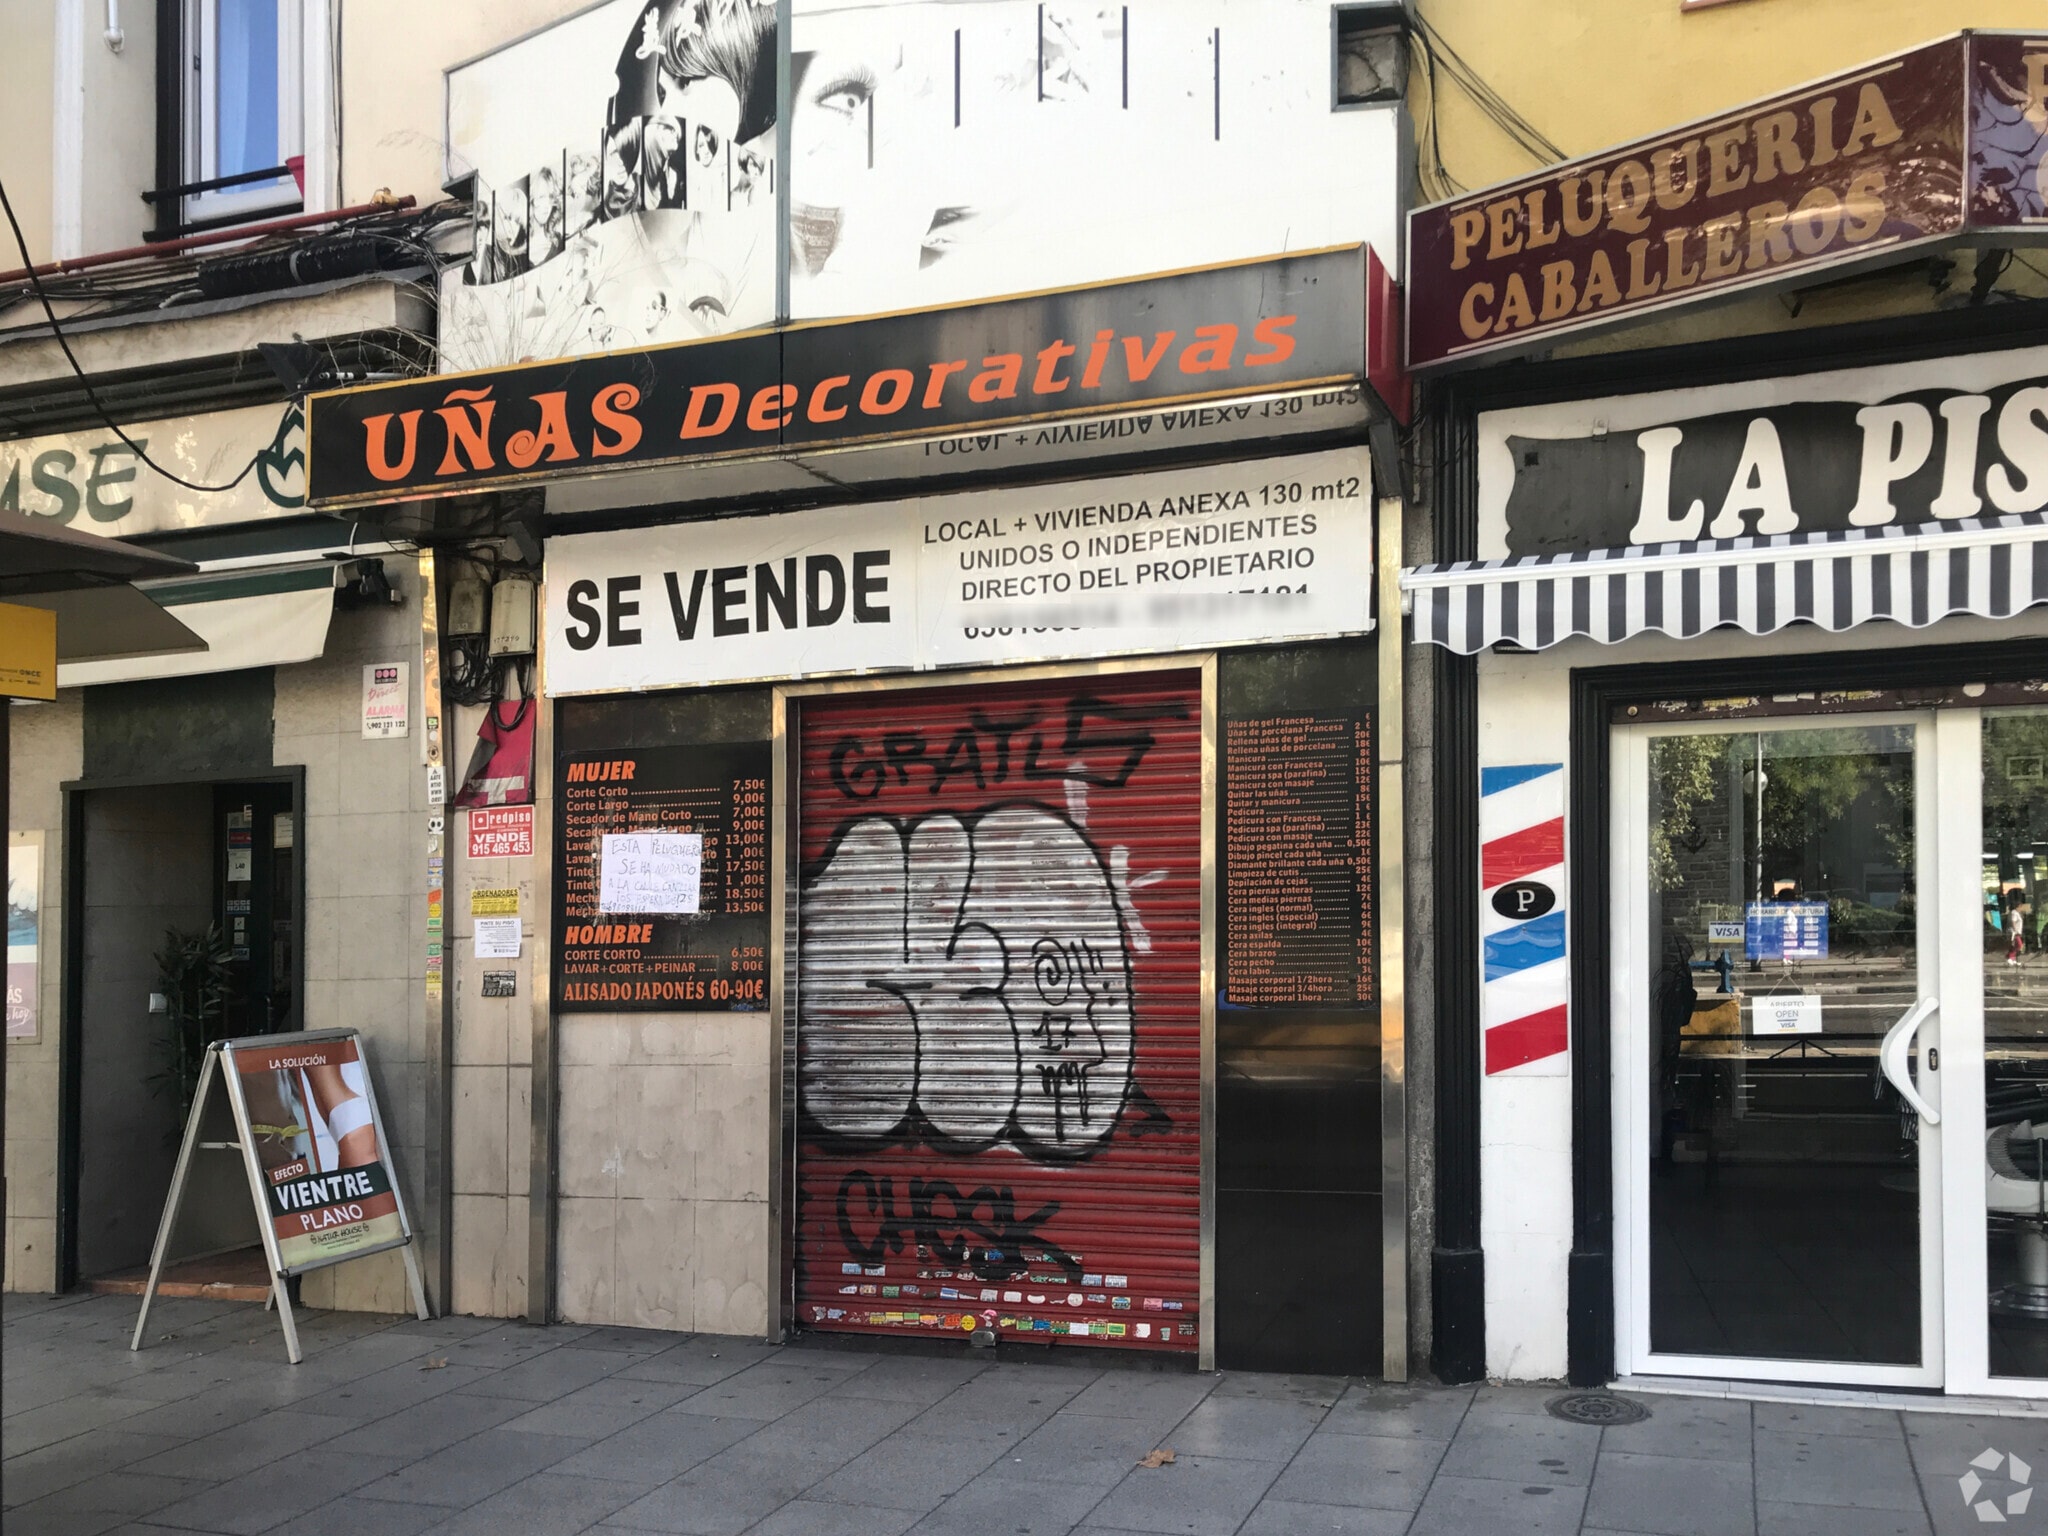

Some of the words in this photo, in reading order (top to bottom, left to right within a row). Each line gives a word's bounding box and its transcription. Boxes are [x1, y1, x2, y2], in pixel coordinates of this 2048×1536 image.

[1449, 82, 1903, 270] PELUQUERIA
[1459, 170, 1888, 340] CABALLEROS
[362, 382, 643, 481] UÑAS
[679, 314, 1297, 440] Decorativas
[1629, 417, 1799, 546] LA
[1848, 386, 2048, 527] PIS
[924, 516, 1006, 544] LOCAL
[1034, 501, 1152, 532] VIVIENDA
[1159, 490, 1251, 518] ANEXA
[1258, 482, 1302, 507] 130
[1312, 477, 1360, 501] mt2
[960, 543, 1053, 570] UNIDOS
[1062, 539, 1080, 559] O
[1088, 513, 1318, 558] INDEPENDIENTES
[962, 572, 1071, 601] DIRECTO
[1079, 566, 1128, 591] DEL
[1136, 546, 1315, 584] PROPIETARIO
[565, 574, 642, 651] SE
[663, 549, 891, 642] VENDE
[1227, 720, 1248, 728] Uñas
[1250, 719, 1259, 727] de
[1261, 718, 1274, 727] gel
[1276, 717, 1314, 726] Francesa
[566, 760, 637, 782] MUJER
[1227, 764, 1264, 772] Manicura
[1285, 761, 1323, 770] Francesa
[566, 788, 596, 798] Corte
[598, 786, 628, 797] Corto
[733, 778, 765, 792] 7,50€
[1227, 790, 1253, 799] Quitar
[1269, 789, 1289, 797] uñas
[566, 801, 596, 811] Corte
[599, 801, 629, 813] Largo
[733, 792, 765, 805] 9,00€
[490, 811, 531, 824] redpiso
[566, 814, 609, 825] Secador
[612, 812, 626, 823] de
[628, 812, 658, 822] Mano
[661, 810, 692, 821] Corto
[733, 806, 765, 819] 7,00€
[566, 827, 609, 838] Secador
[733, 820, 765, 832] 9,00€
[1227, 826, 1264, 834] Pedicura
[1266, 826, 1281, 834] spa
[1282, 822, 1325, 832] (parafina)
[474, 831, 529, 843] VENDE
[725, 834, 765, 846] 13,00€
[472, 844, 490, 855] 915
[492, 843, 510, 854] 465
[512, 841, 530, 853] 453
[1228, 844, 1255, 853] Dibujo
[1257, 842, 1293, 851] pegatina
[1316, 840, 1332, 848] uña
[567, 867, 593, 877] Tinte
[726, 861, 765, 873] 17,50€
[1228, 861, 1267, 869] Diamante
[1269, 859, 1305, 867] brillante
[1307, 858, 1327, 866] cada
[1329, 857, 1345, 865] uña
[1228, 869, 1265, 878] Limpieza
[1279, 868, 1299, 876] cutis
[566, 880, 593, 890] Tinte
[1228, 888, 1248, 896] Cera
[1249, 887, 1280, 895] piernas
[1282, 886, 1313, 894] enteras
[566, 893, 600, 903] Mecha
[1515, 889, 1537, 912] P
[566, 906, 602, 916] Mecha
[725, 902, 765, 914] 13,50€
[565, 924, 653, 944] HOMBRE
[1715, 928, 1740, 936] VISA
[564, 950, 600, 960] CORTE
[603, 949, 641, 960] CORTO
[731, 947, 764, 959] 6,50€
[731, 960, 764, 973] 8,00€
[7, 985, 22, 1004] ÁS
[564, 982, 632, 1001] ALISADO
[635, 976, 705, 1001] JAPONÉS
[709, 979, 764, 1000] 60-90€
[1228, 994, 1257, 1002] Masaje
[1259, 994, 1295, 1002] corporal
[1775, 1010, 1799, 1018] OPEN
[269, 1060, 281, 1069] LA
[282, 1054, 327, 1068] SOLUCIÓN
[274, 1163, 304, 1181] EFECTO
[275, 1171, 374, 1211] VIENTRE
[300, 1204, 364, 1232] PLANO
